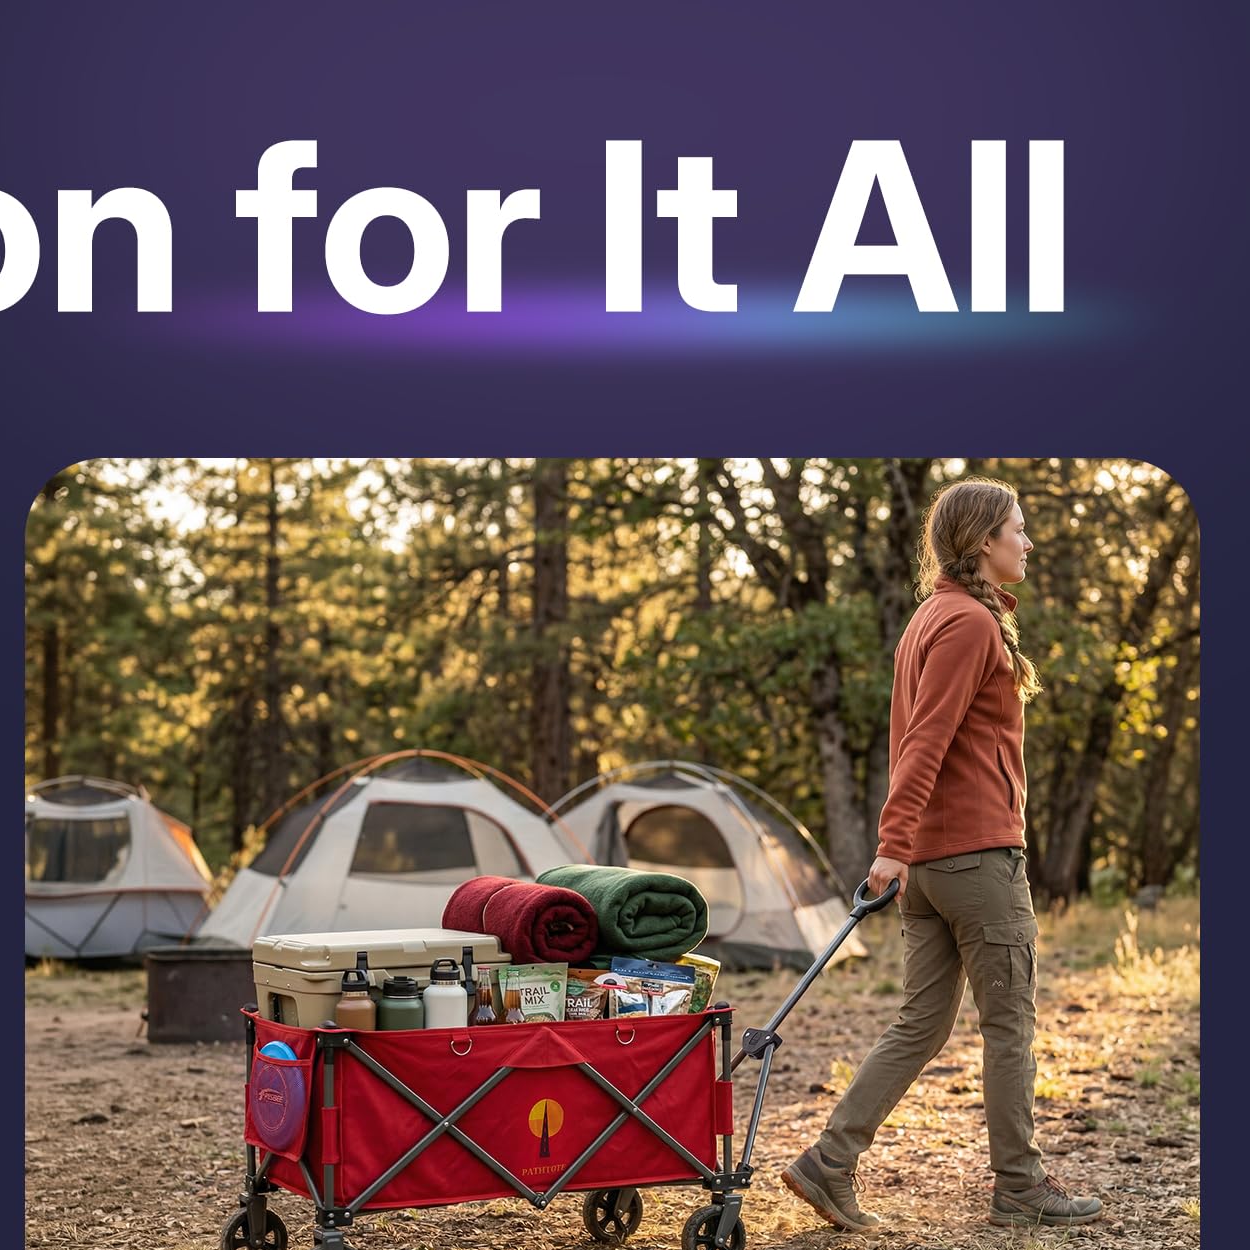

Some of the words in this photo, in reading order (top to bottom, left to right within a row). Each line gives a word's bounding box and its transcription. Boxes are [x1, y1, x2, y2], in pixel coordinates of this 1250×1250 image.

[520, 986, 550, 997] TRAIL
[524, 995, 545, 1005] MIX
[566, 998, 593, 1008] RAIL
